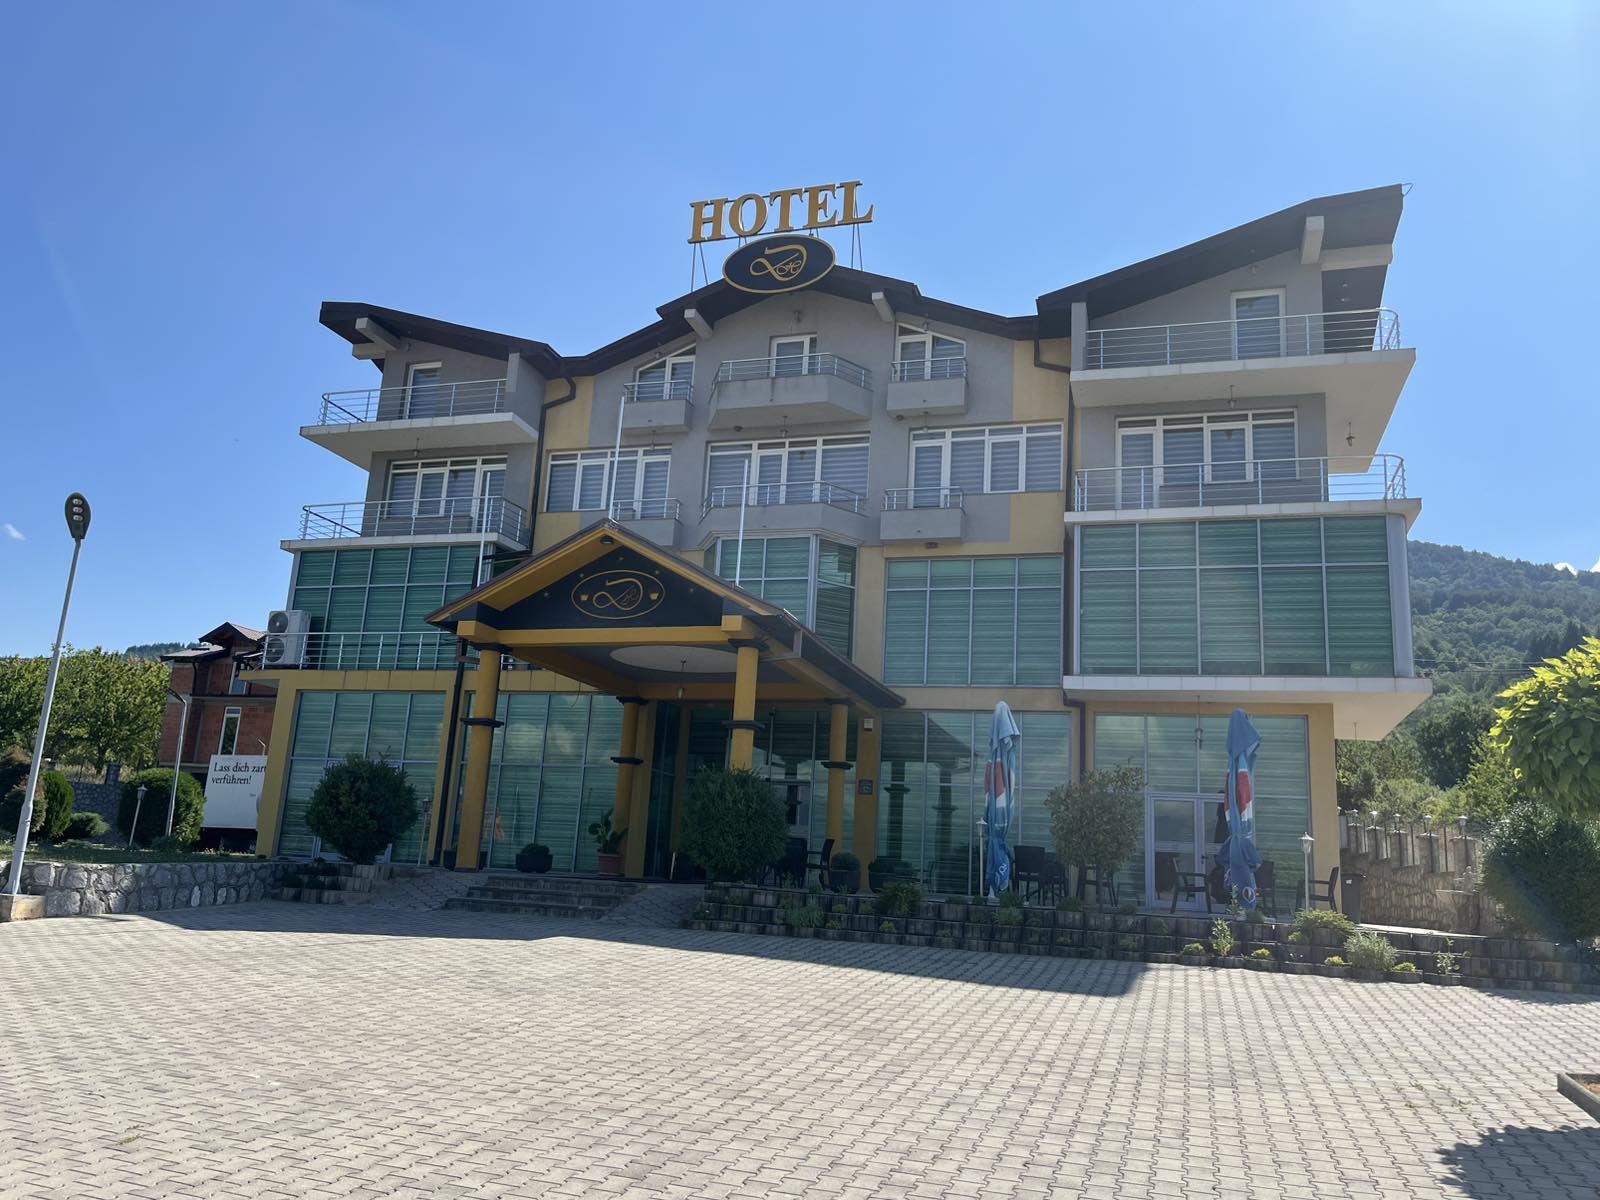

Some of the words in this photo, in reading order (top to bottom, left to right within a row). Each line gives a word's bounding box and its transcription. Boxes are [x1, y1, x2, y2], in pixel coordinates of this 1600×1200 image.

[688, 181, 873, 243] HOTEL
[214, 762, 231, 772] Lass
[232, 762, 249, 773] dich
[212, 774, 251, 784] verführen!
